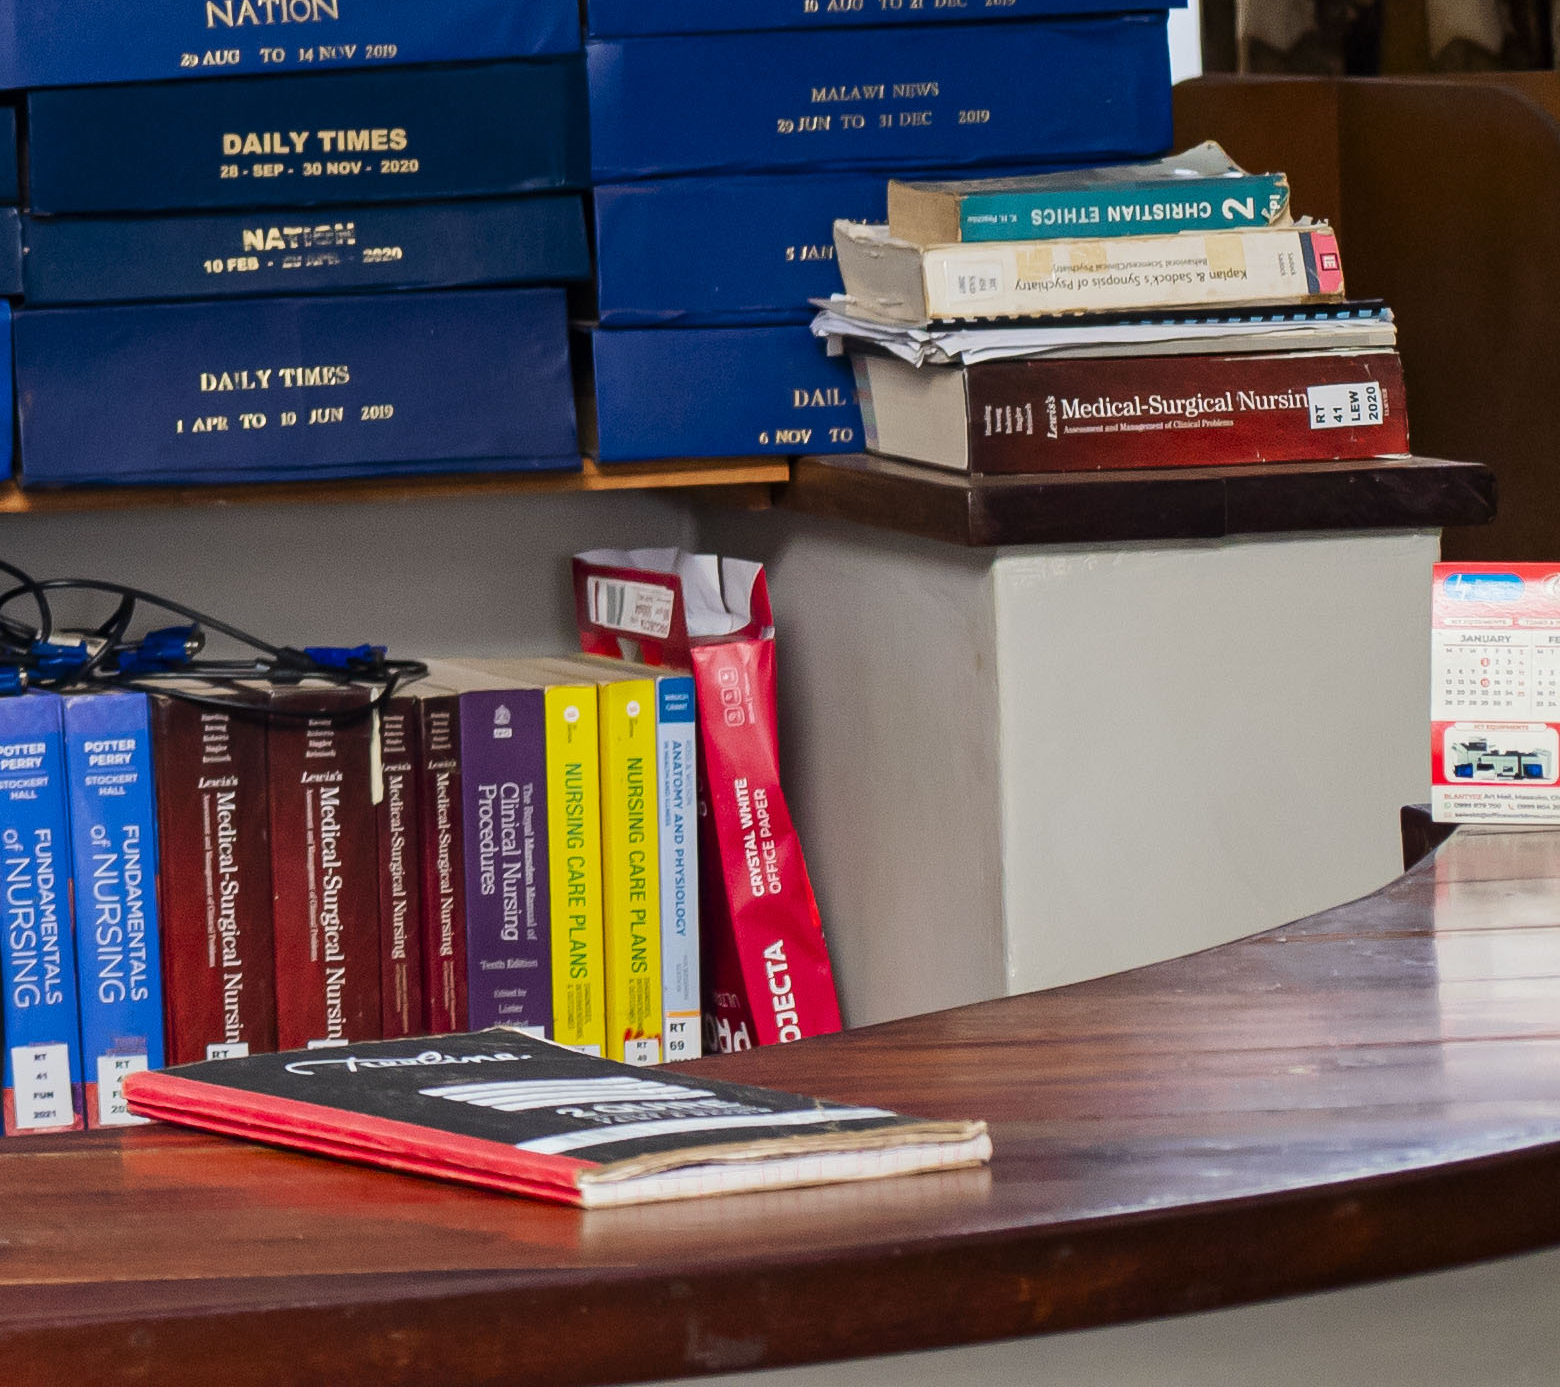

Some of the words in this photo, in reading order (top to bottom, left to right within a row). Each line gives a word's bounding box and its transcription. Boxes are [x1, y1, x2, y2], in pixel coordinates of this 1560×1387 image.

[1031, 207, 1099, 225] ETHICS
[1108, 202, 1211, 222] CHRISTIAN
[1062, 392, 1233, 419] Medical-Surgical
[1315, 404, 1325, 424] RT
[1333, 407, 1343, 423] 41
[1351, 391, 1361, 421] LEW
[1368, 386, 1379, 420] 2020
[1461, 635, 1511, 643] JANUARY
[0, 757, 42, 770] PERRY
[671, 740, 683, 807] ANATOMY
[498, 782, 520, 857] Clinical
[565, 763, 585, 849] NURSING
[673, 813, 684, 844] AND
[734, 778, 750, 830] WHITE
[753, 789, 773, 838] PAPER
[4, 831, 24, 852] of
[477, 784, 496, 896] Procedures
[742, 831, 763, 897] CRYSTAL
[567, 856, 585, 907] CARE
[675, 848, 686, 937] PHYSIOLOGY
[764, 841, 782, 895] OFFICE
[34, 828, 62, 1005] FUNDAMENTALS
[500, 861, 521, 942] Nursing
[6, 859, 40, 1008] NURSING
[569, 915, 588, 979] PLANS
